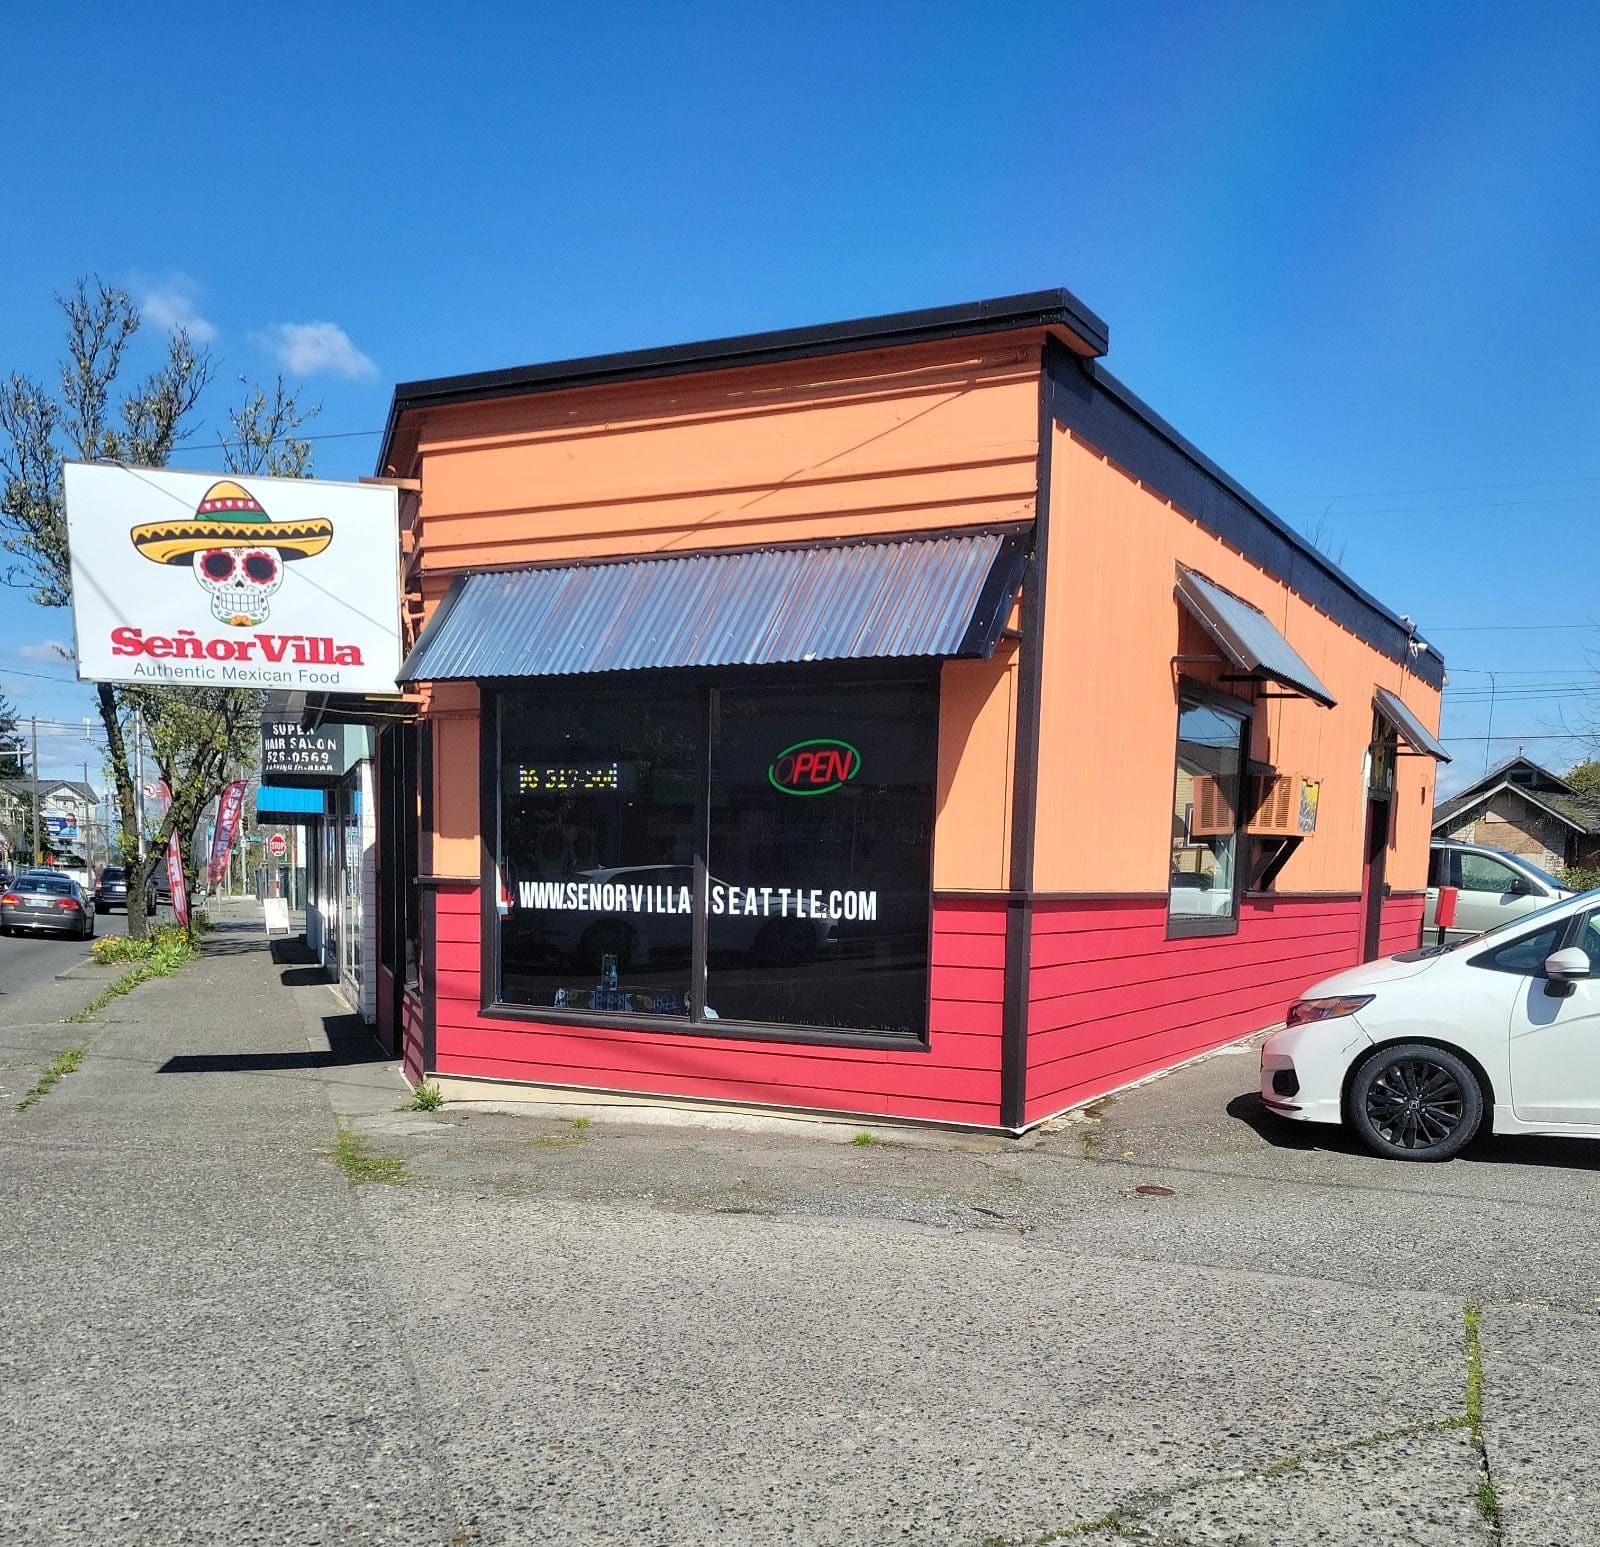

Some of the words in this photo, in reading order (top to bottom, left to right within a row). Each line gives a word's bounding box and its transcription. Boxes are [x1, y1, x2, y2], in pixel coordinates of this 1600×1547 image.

[133, 662, 216, 679] Authentic
[222, 666, 292, 682] Mexican
[299, 669, 340, 684] Food
[265, 738, 285, 750] HAIR
[290, 737, 337, 750] SALON
[775, 750, 852, 784] OPEN
[271, 841, 286, 850] STOP
